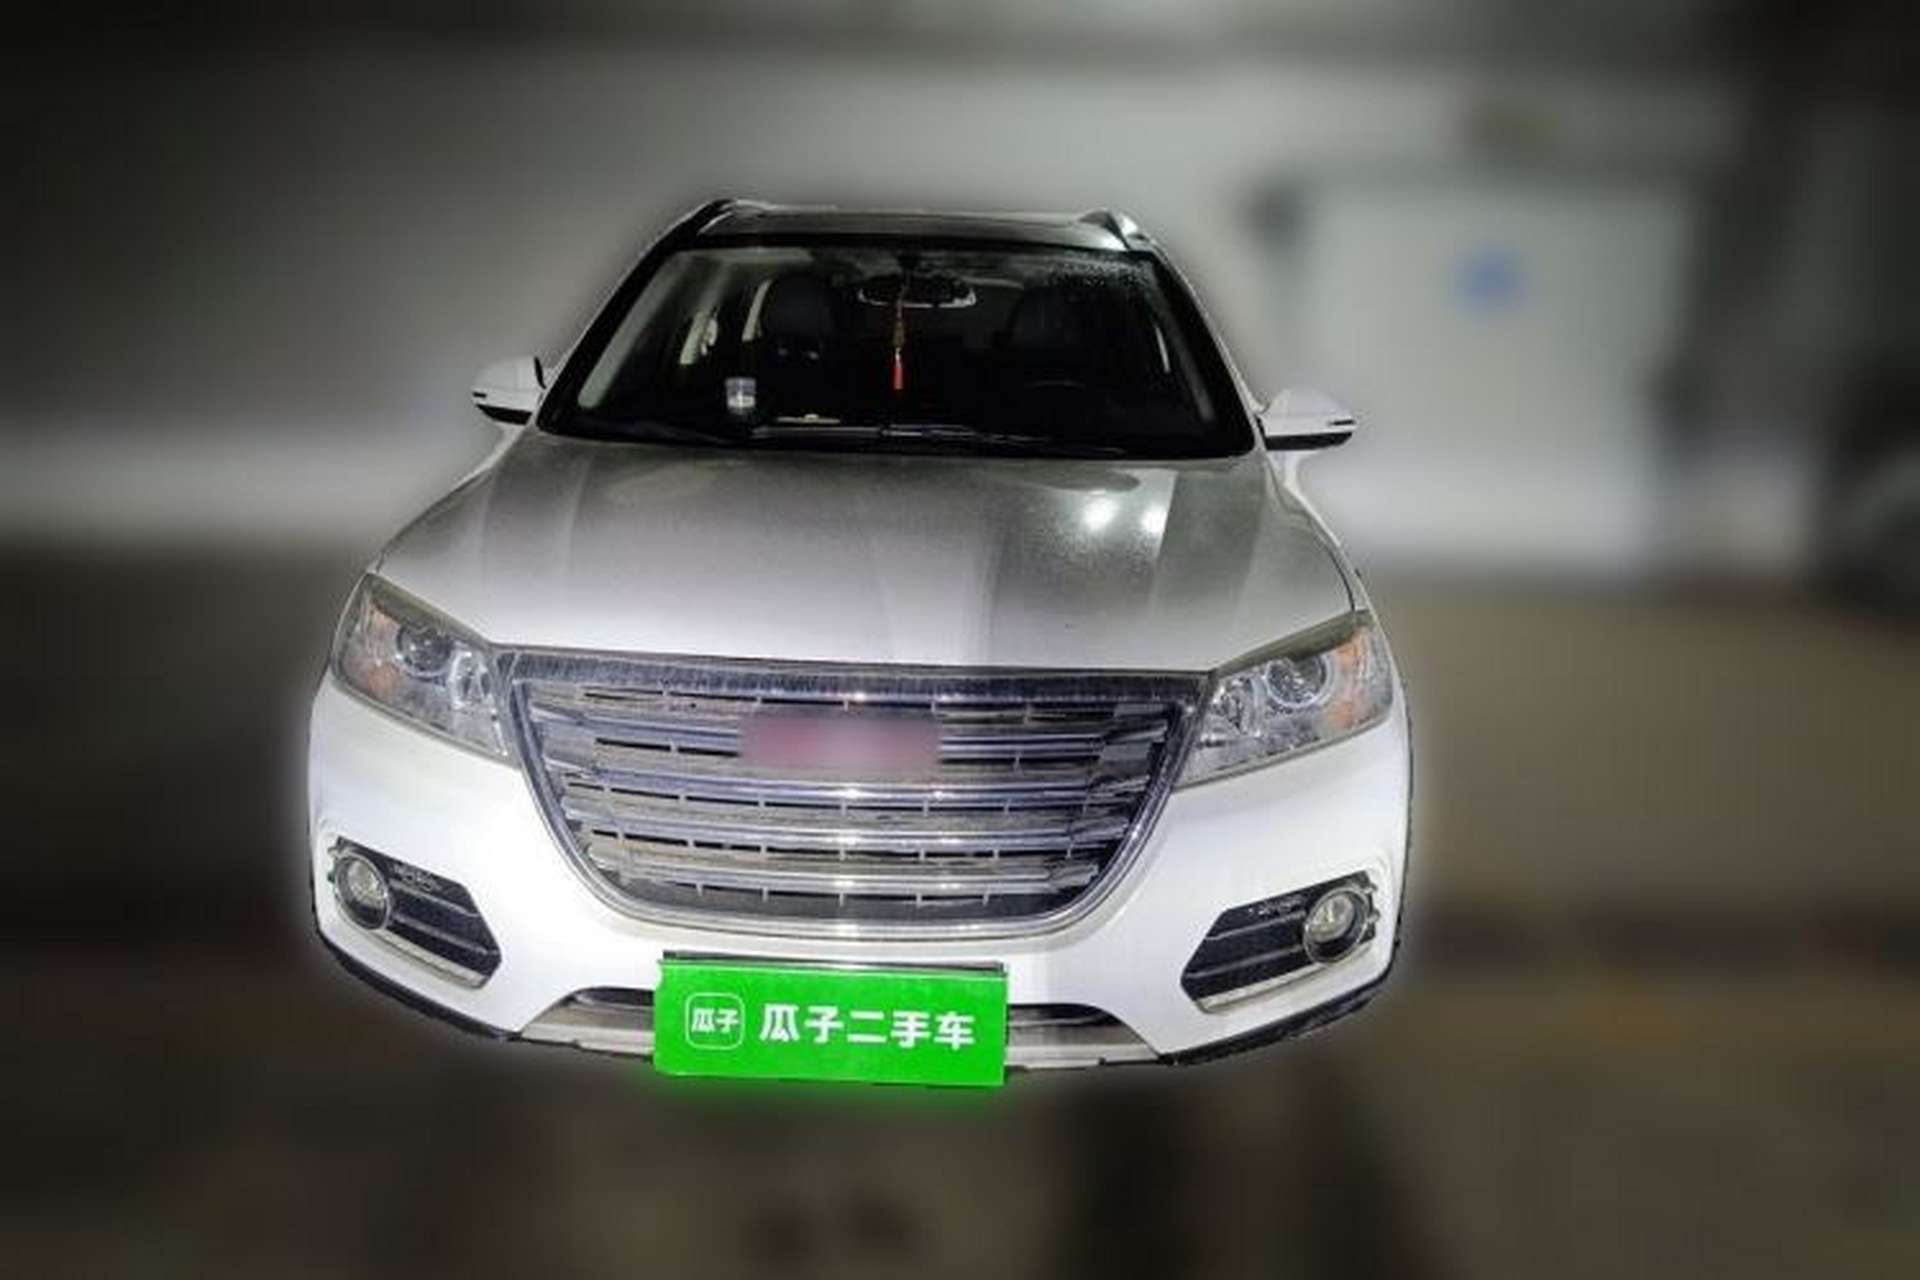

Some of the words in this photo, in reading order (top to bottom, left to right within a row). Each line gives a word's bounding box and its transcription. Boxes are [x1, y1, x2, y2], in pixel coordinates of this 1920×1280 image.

[691, 1007, 740, 1034] 瓜子
[759, 1003, 976, 1050] 瓜子二手车
